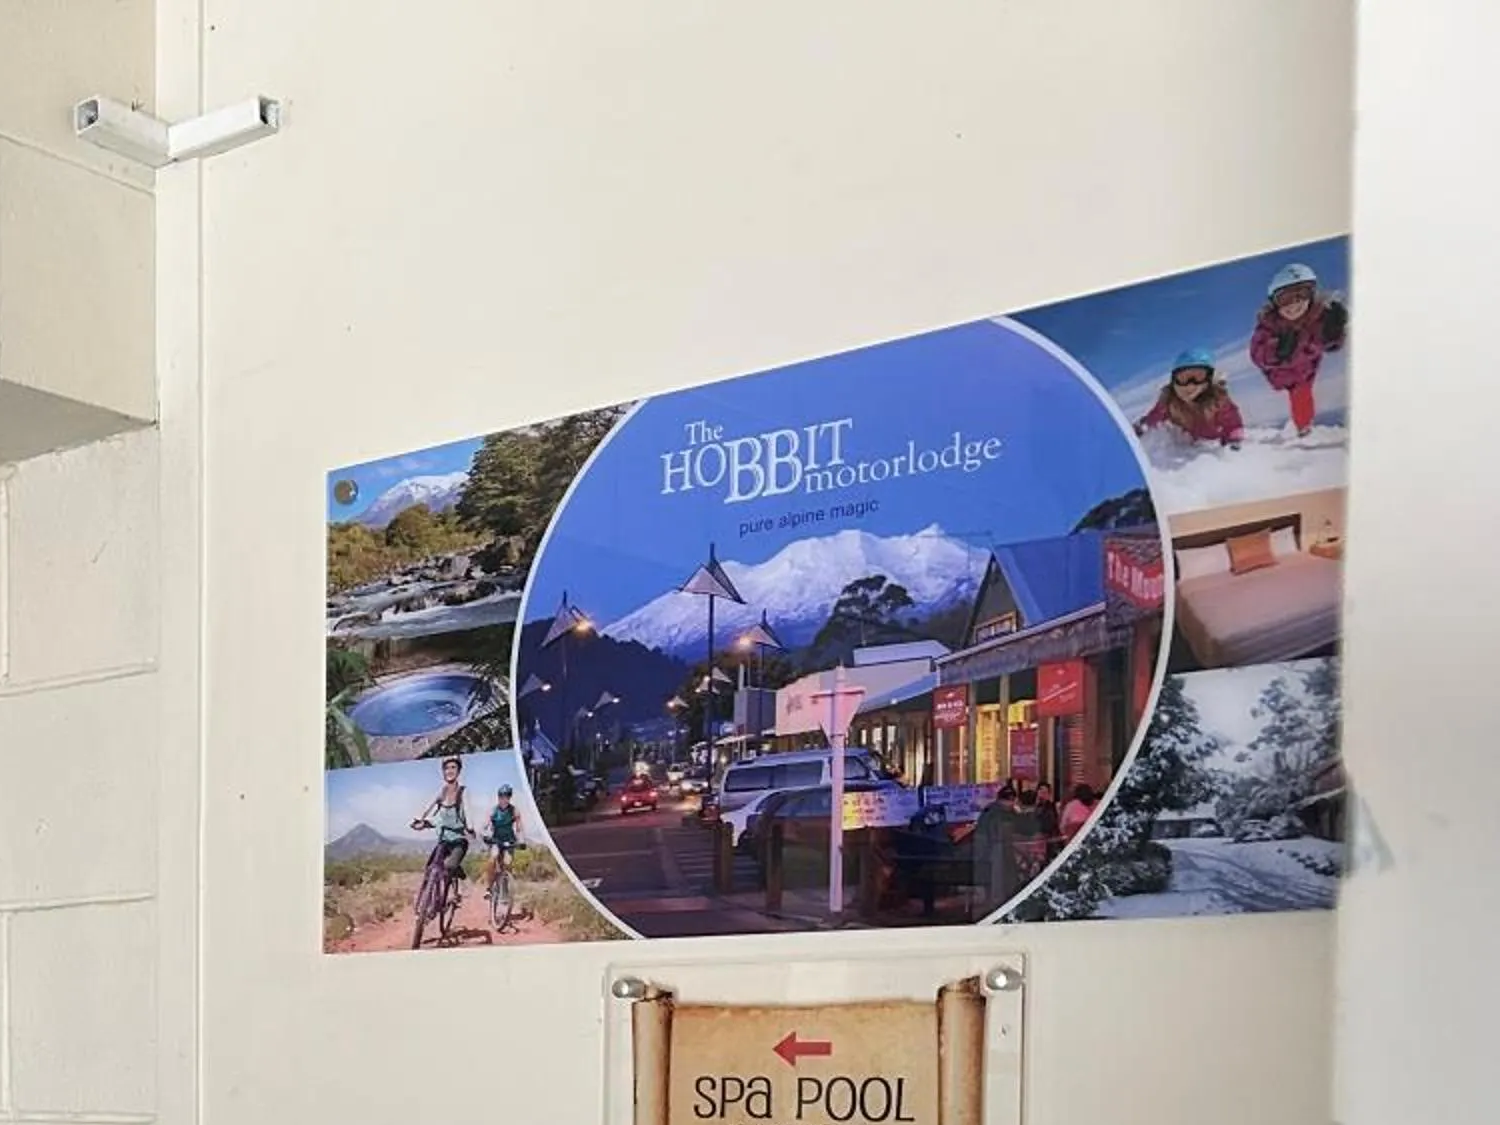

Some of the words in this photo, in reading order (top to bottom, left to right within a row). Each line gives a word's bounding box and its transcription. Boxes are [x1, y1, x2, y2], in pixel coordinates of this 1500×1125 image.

[684, 419, 724, 446] The
[660, 418, 853, 504] HOBBIT
[804, 431, 1001, 494] motorlodge
[739, 518, 774, 538] pure
[778, 509, 825, 531] alpine
[830, 499, 880, 520] magic
[796, 1076, 915, 1122] POOL
